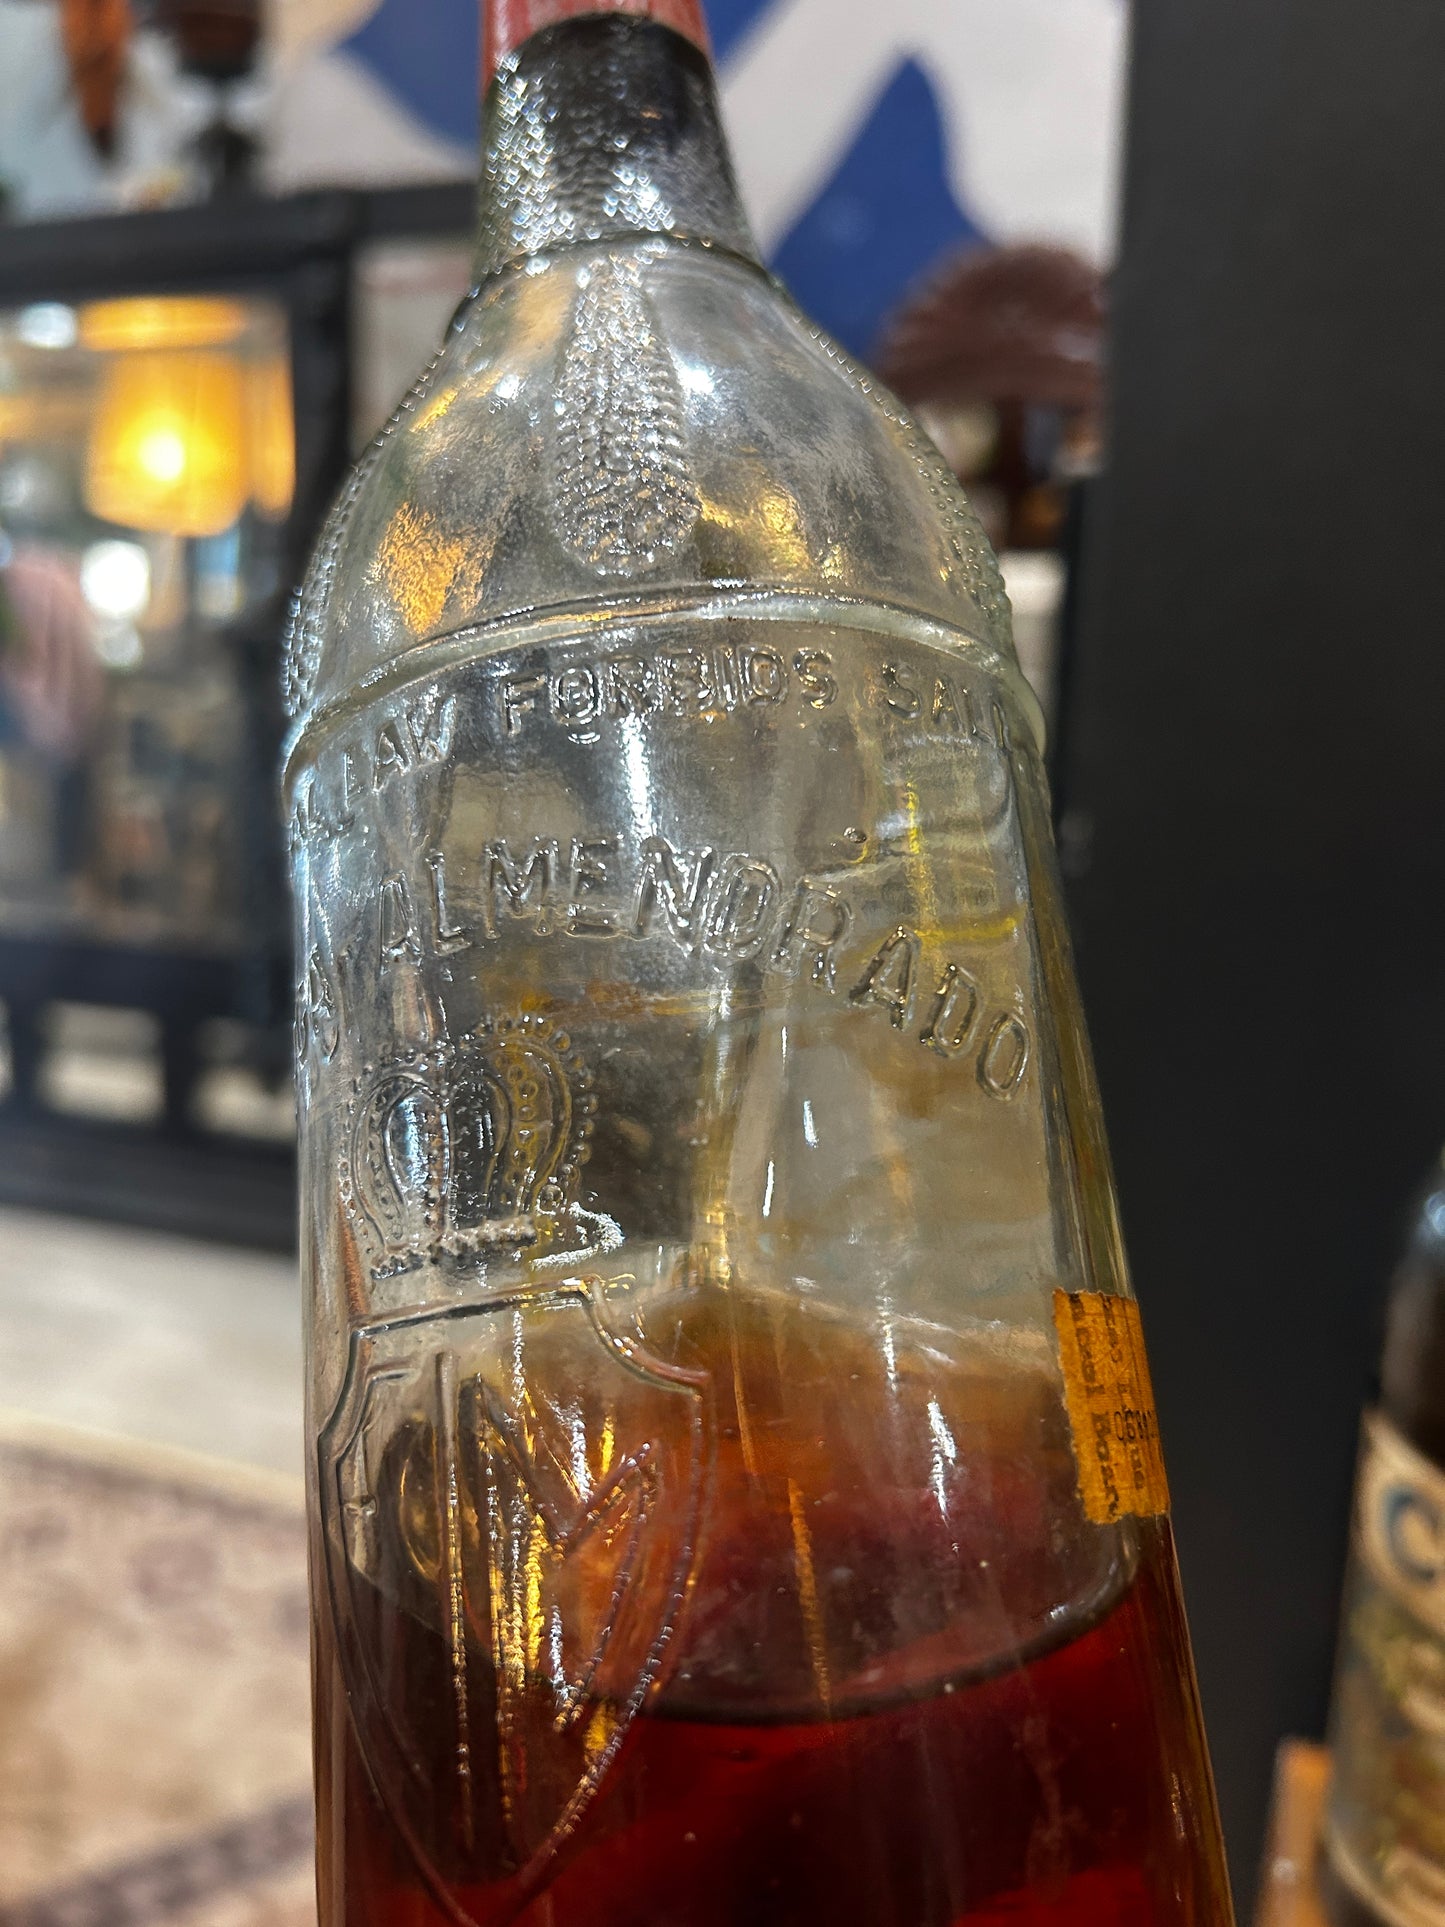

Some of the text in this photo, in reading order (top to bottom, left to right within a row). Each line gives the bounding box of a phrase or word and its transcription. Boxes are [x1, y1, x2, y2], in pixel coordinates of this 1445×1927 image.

[342, 684, 458, 814] LAW
[502, 645, 840, 738] FORBIDS
[378, 831, 1032, 1101] ALMENDRADO
